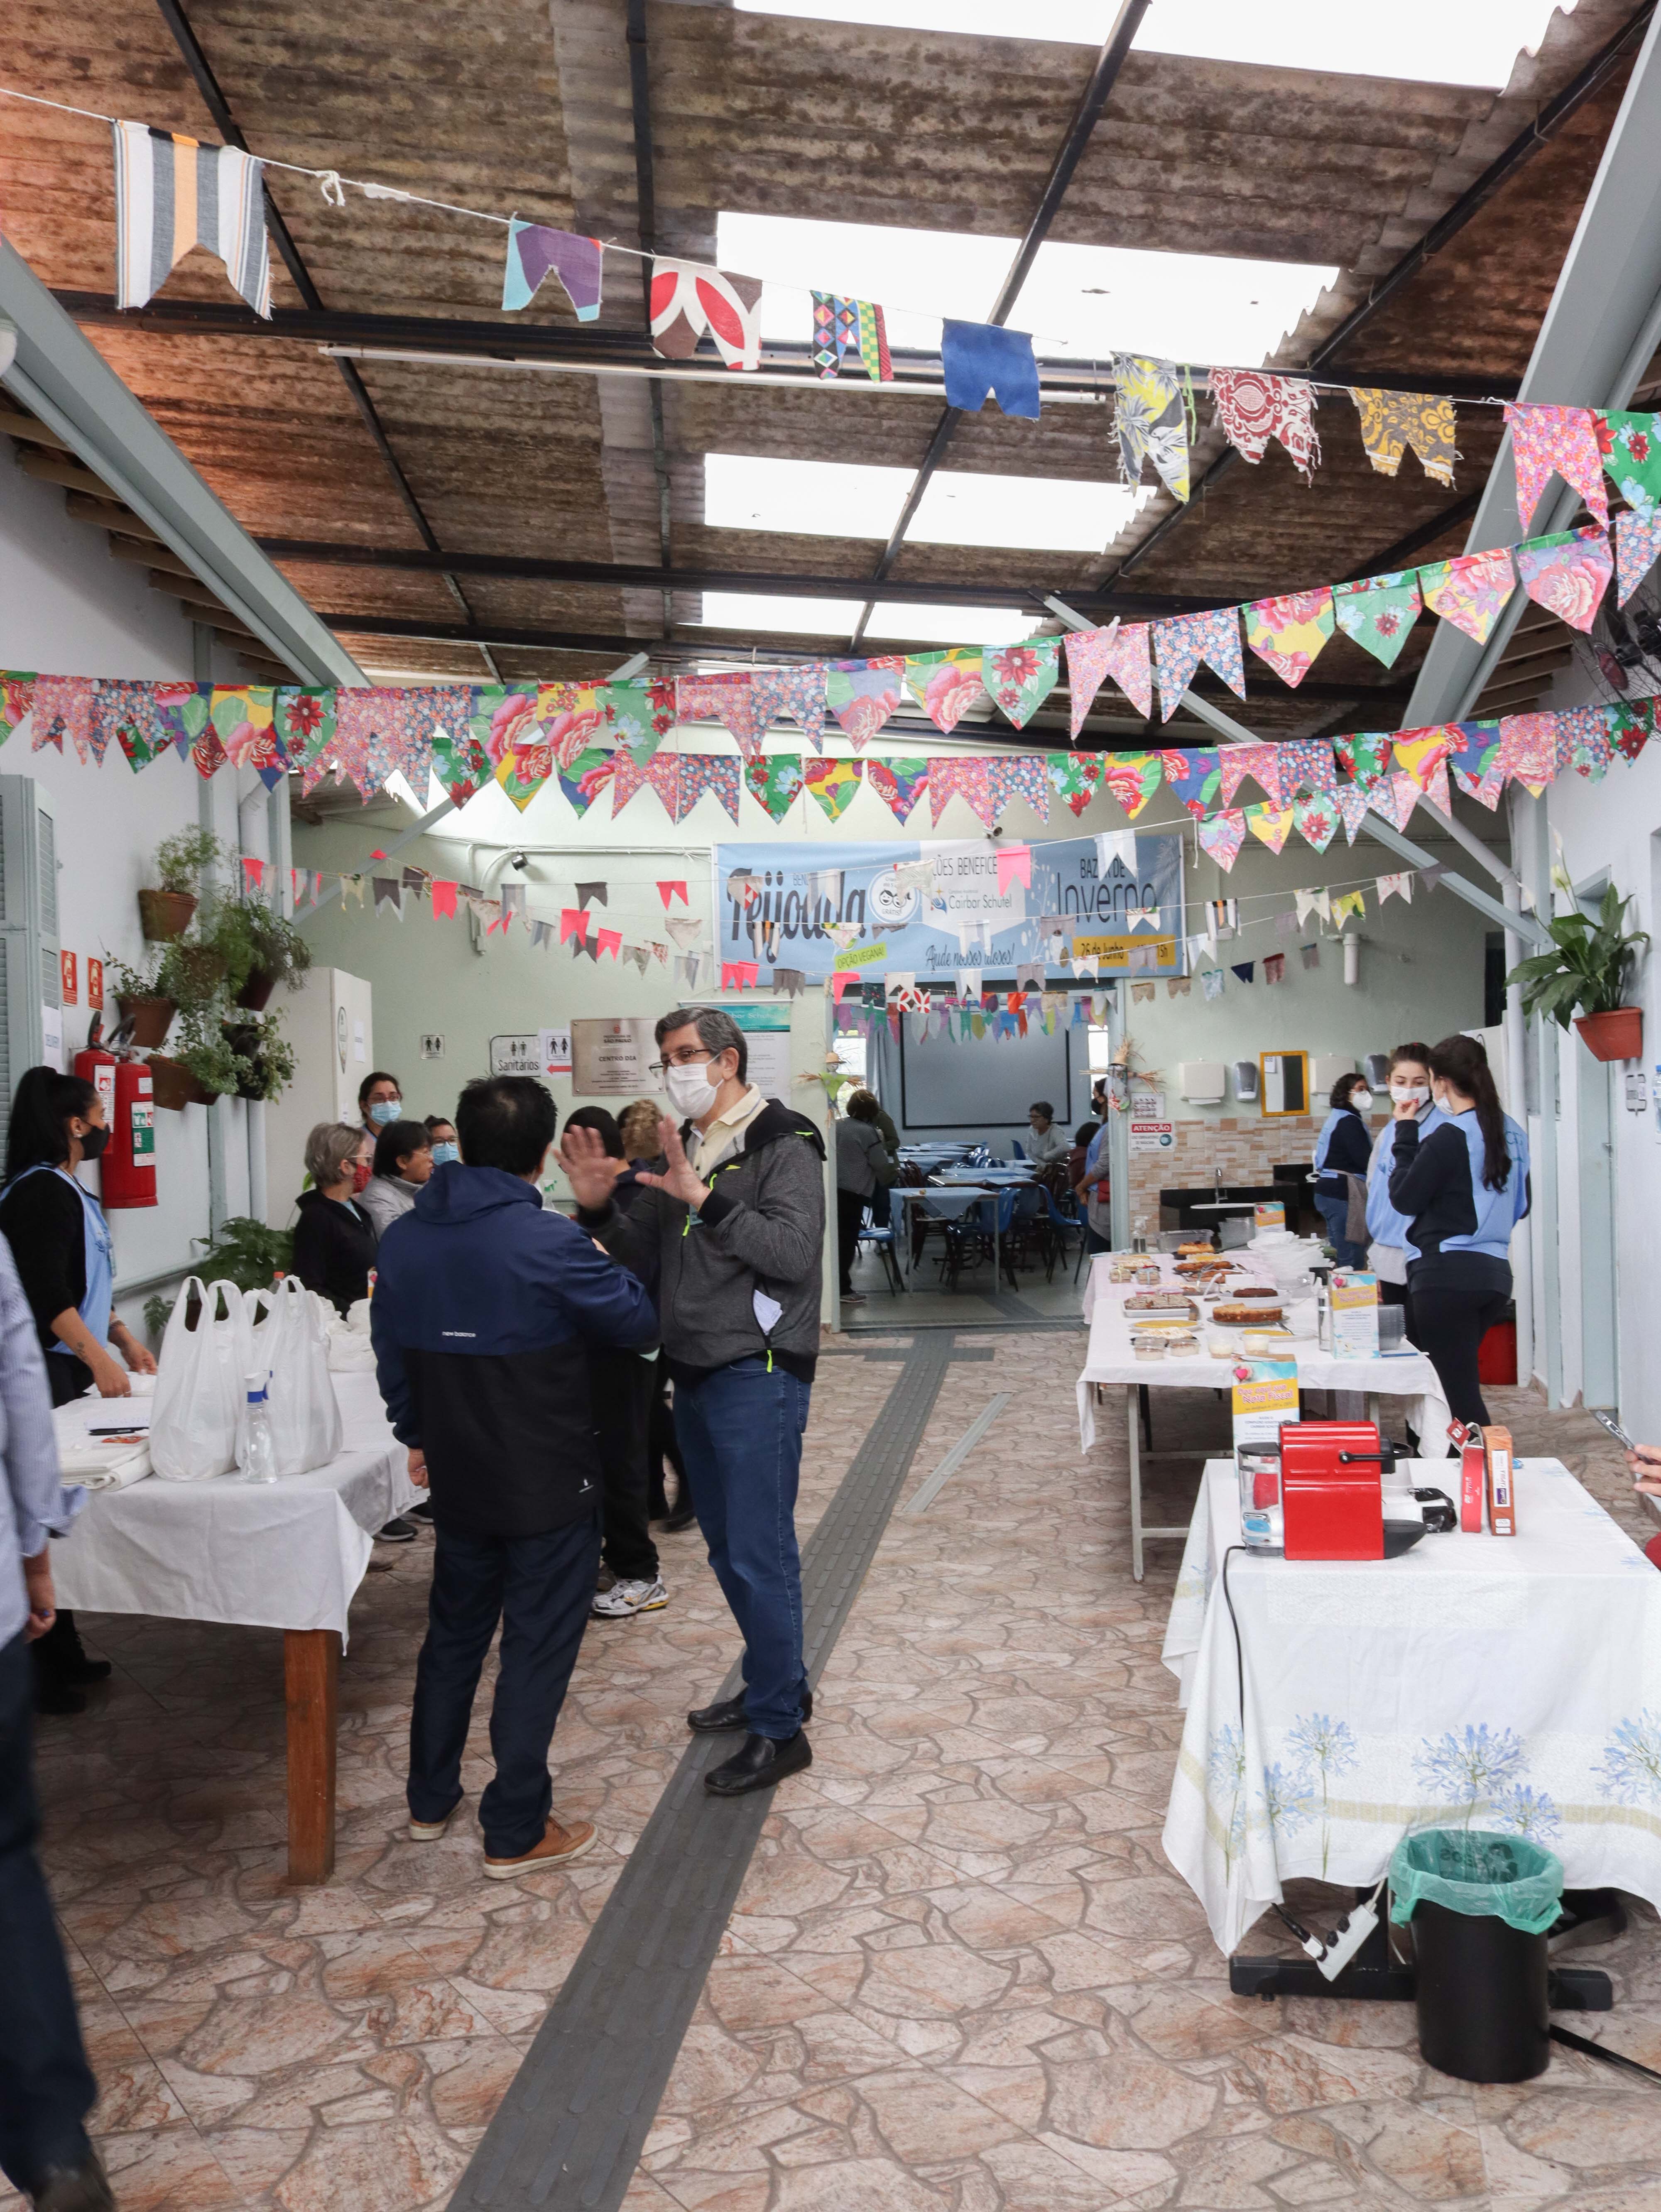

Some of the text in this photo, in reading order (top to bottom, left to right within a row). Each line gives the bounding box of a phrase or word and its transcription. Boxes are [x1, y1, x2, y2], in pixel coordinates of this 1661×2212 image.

[932, 854, 998, 880] ÇÕES BENEFICE
[948, 894, 1012, 909] Cairbar Schutel
[1057, 872, 1157, 922] Inverno
[926, 944, 951, 974] Ajude
[498, 1059, 539, 1071] Sanitários
[1133, 1123, 1170, 1132] ATENÇÃO
[1242, 1389, 1294, 1405] Nota Fiscal
